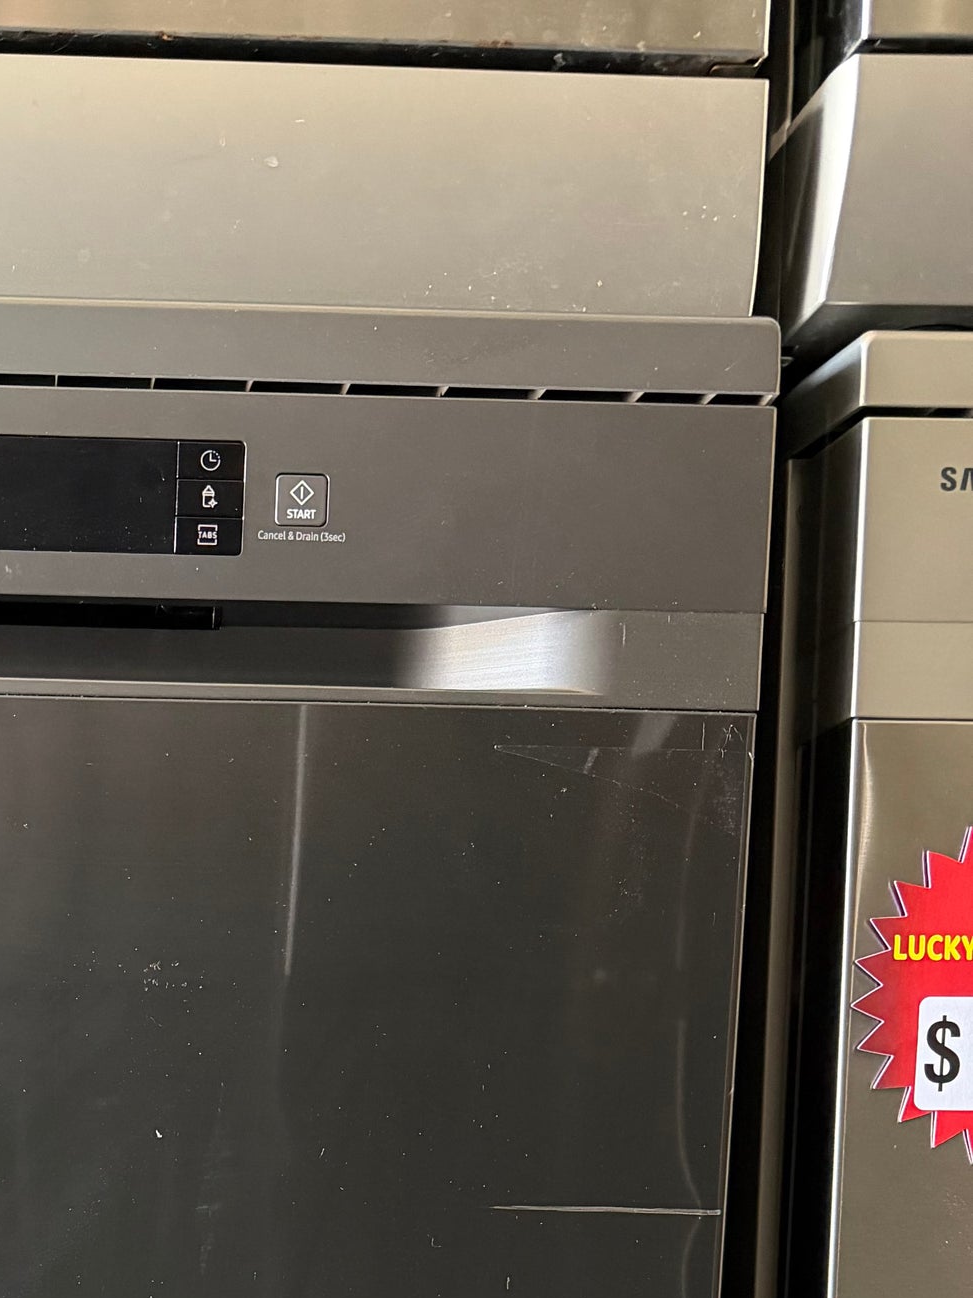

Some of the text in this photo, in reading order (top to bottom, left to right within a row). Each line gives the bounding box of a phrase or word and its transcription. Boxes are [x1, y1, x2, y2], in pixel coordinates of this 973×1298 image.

[286, 509, 317, 520] START
[197, 531, 218, 539] TABS
[257, 530, 346, 543] Cancel & Drain (3sec)
[892, 934, 973, 961] LUCKY
[923, 1015, 961, 1092] $
